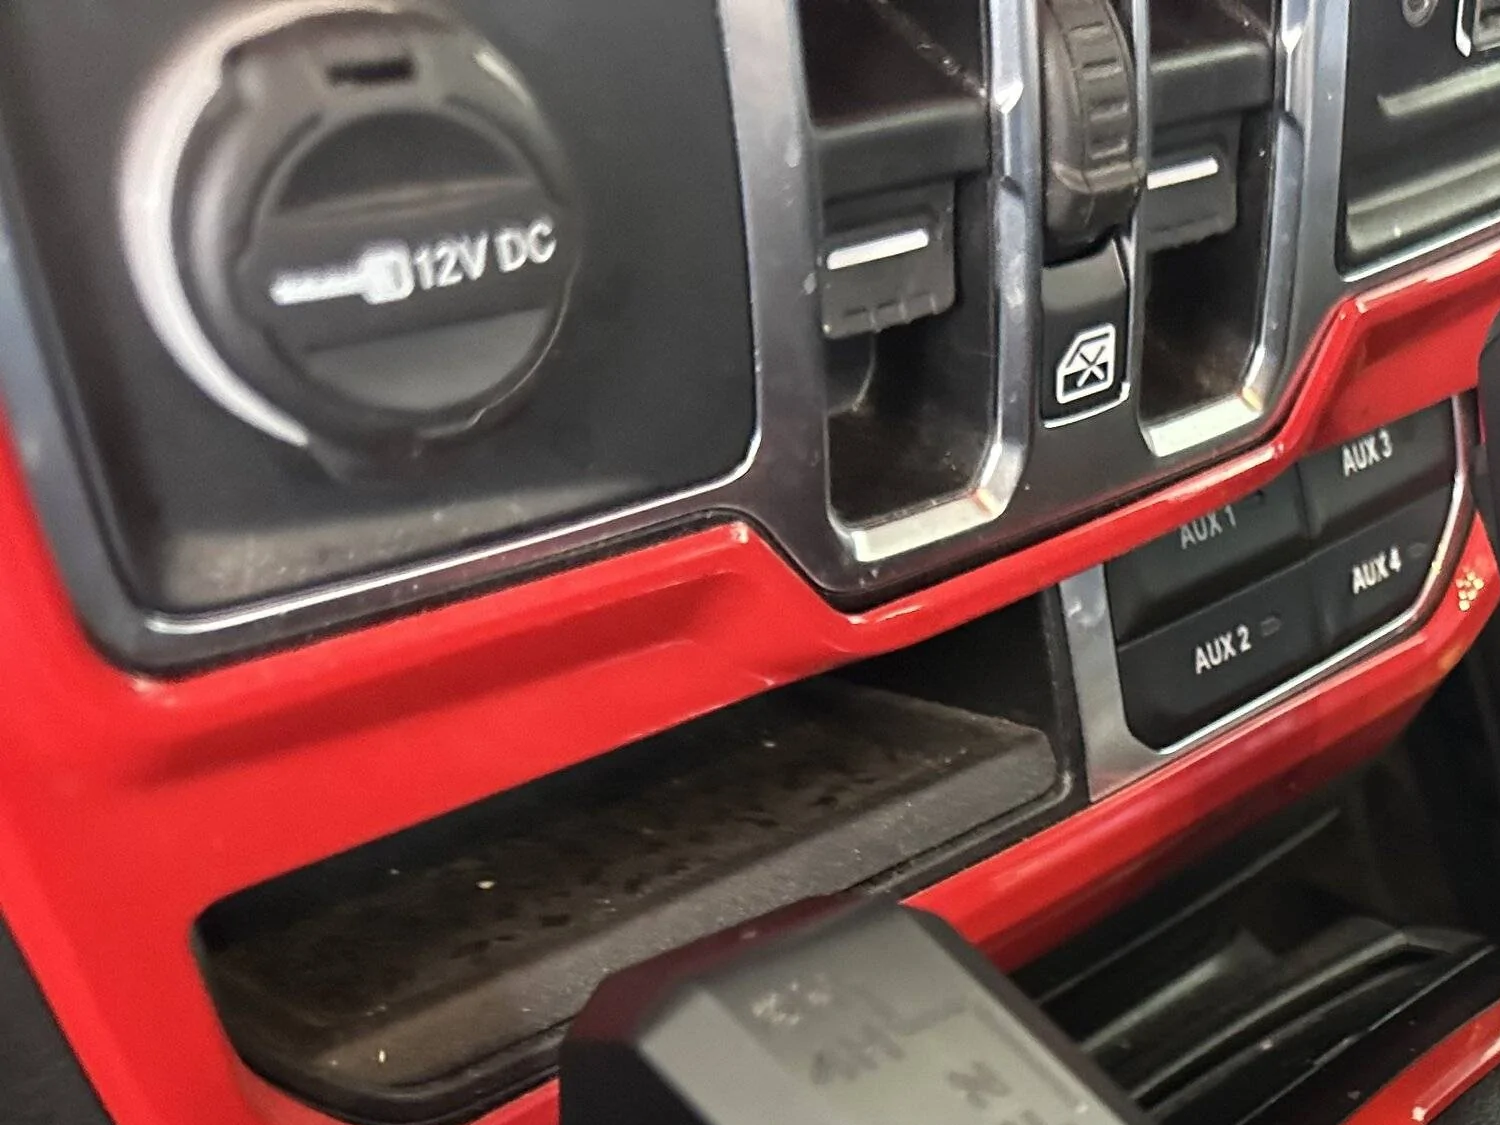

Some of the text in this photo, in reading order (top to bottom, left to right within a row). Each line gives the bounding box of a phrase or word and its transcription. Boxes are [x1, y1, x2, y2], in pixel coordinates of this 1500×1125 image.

[413, 214, 557, 291] 12V DC
[1341, 429, 1393, 477] AUX 3
[1180, 504, 1237, 550] AUX 1
[1352, 546, 1402, 594] AUX 4
[1195, 625, 1252, 675] AUX 2
